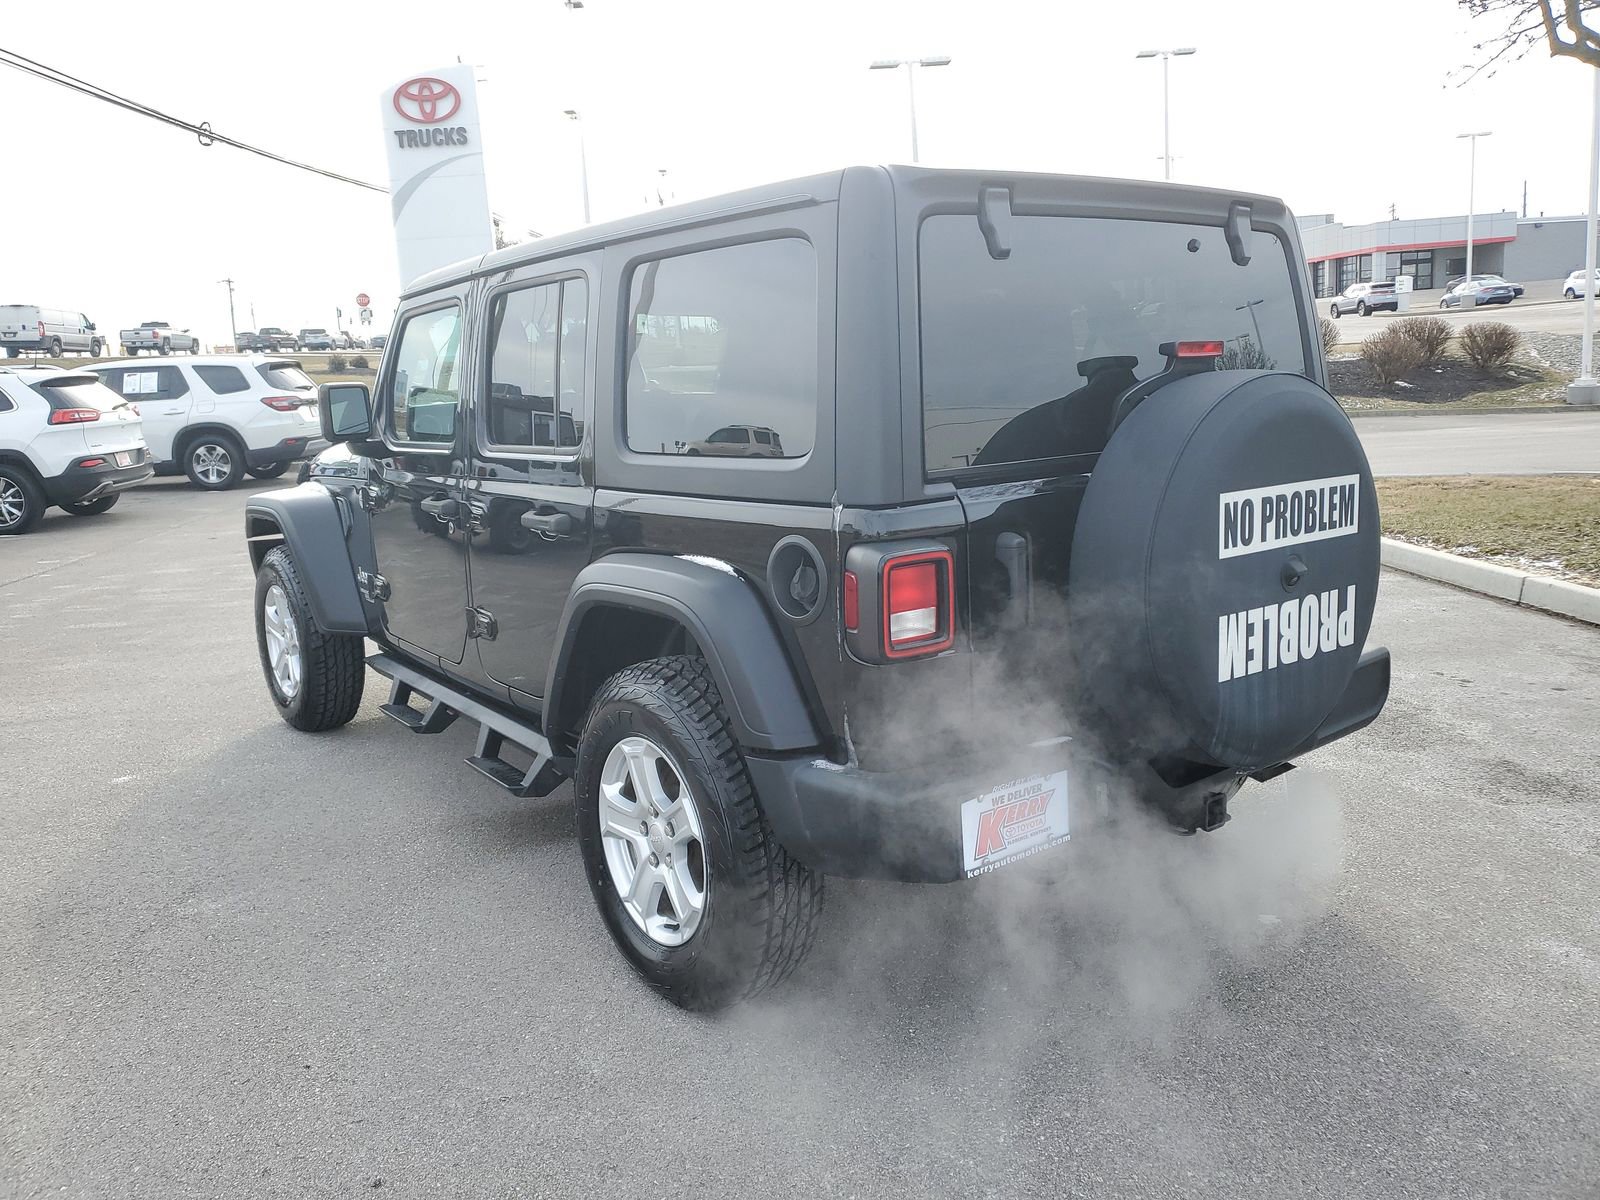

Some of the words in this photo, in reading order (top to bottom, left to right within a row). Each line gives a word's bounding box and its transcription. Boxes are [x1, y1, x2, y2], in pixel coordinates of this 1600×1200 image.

[394, 127, 468, 149] TRUCKS
[1223, 498, 1255, 550] NO
[1260, 483, 1356, 543] PROBLEM
[1218, 584, 1356, 683] PROBLEM
[991, 794, 1006, 807] WE
[1007, 783, 1042, 802] DELIVER
[974, 788, 1056, 861] KERRY
[1017, 817, 1044, 833] TOYOTA
[967, 834, 1071, 879] kerryautomotive.com
